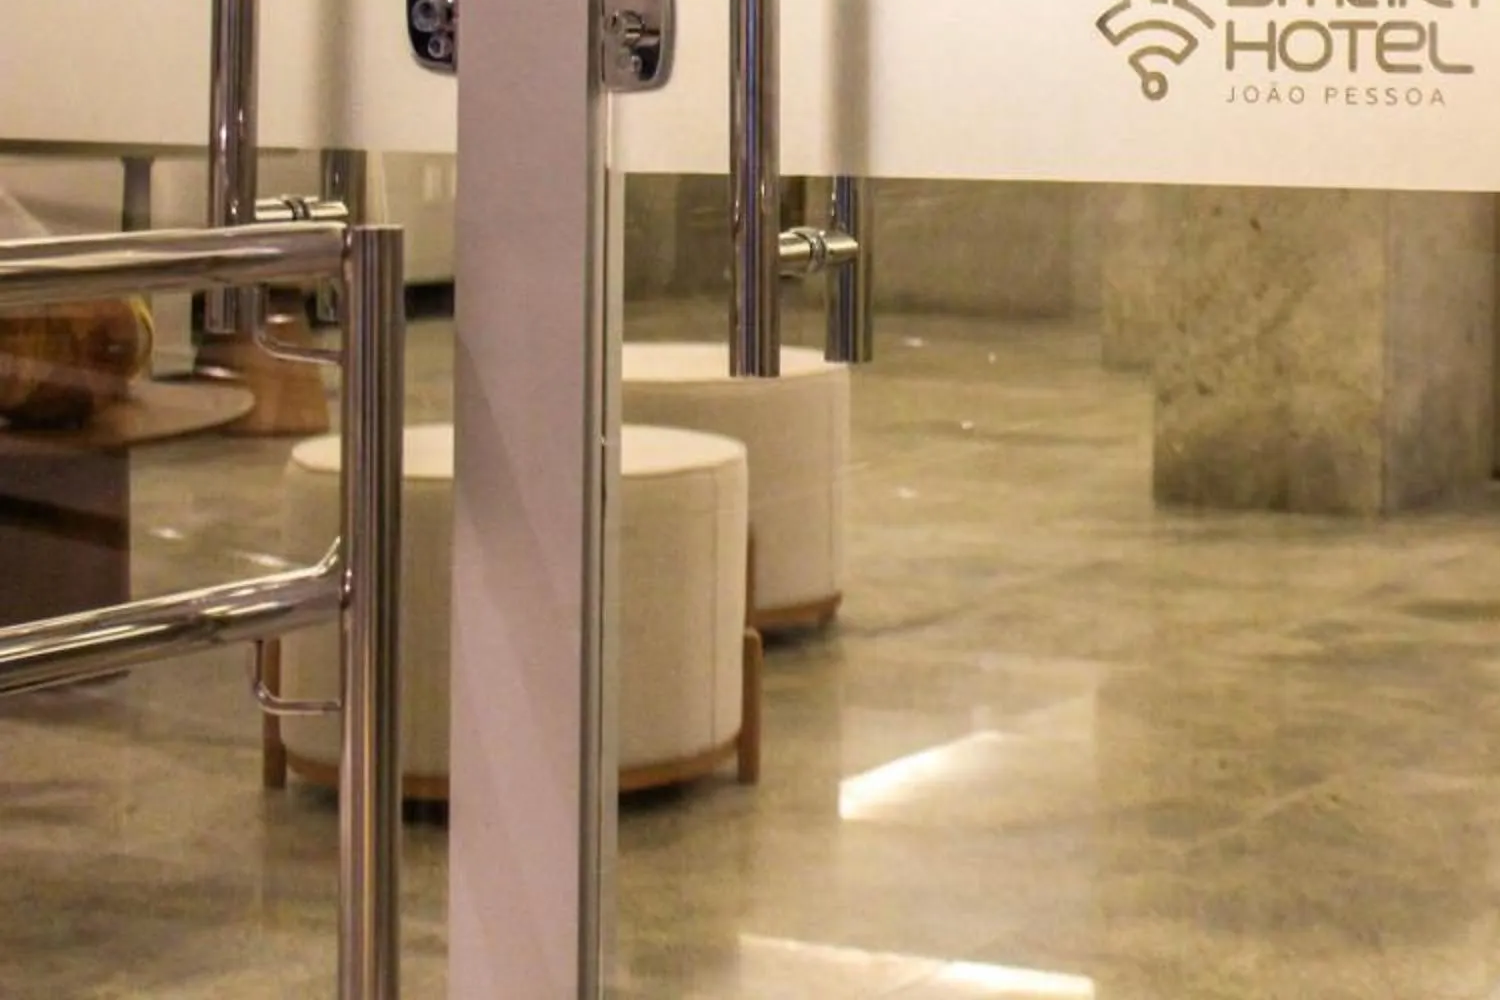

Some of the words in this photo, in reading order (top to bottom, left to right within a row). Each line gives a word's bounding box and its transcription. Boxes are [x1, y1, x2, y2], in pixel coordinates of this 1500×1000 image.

[1225, 20, 1475, 74] HOTEL
[1226, 80, 1306, 106] JOÃO
[1323, 86, 1447, 108] PESSOA
